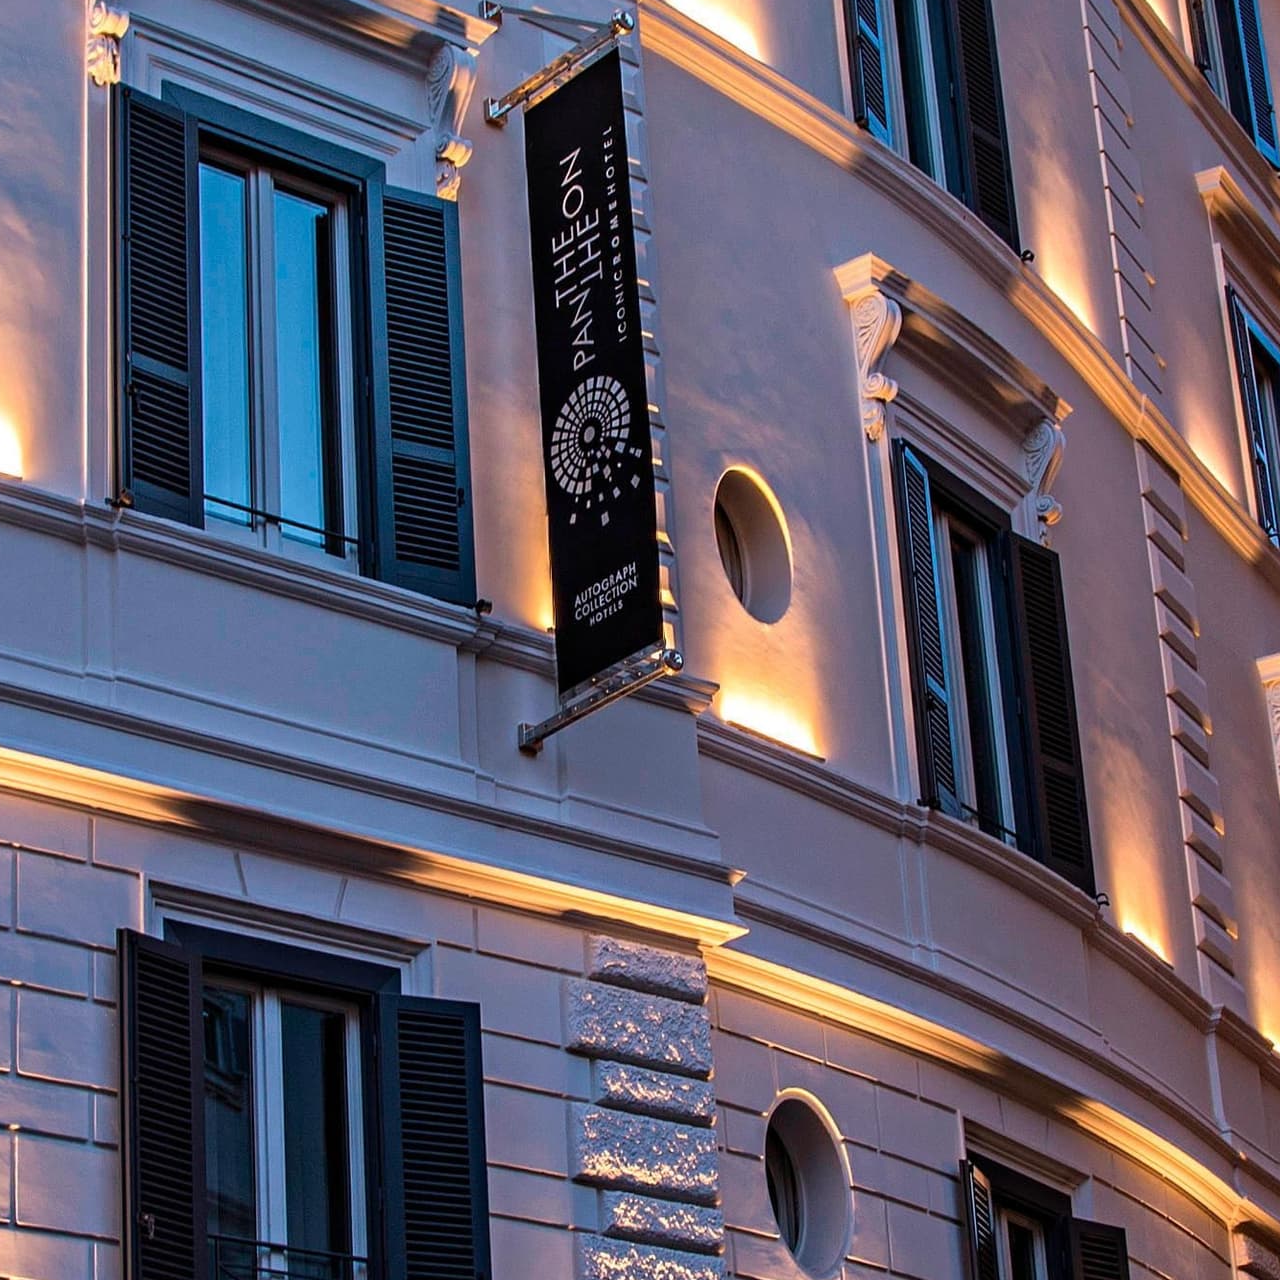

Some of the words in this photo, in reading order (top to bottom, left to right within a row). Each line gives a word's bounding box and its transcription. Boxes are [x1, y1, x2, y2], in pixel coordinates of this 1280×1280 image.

[574, 561, 636, 608] AUTOGRAPH
[575, 576, 637, 620] COLLECTION
[590, 600, 623, 626] HOTELS
